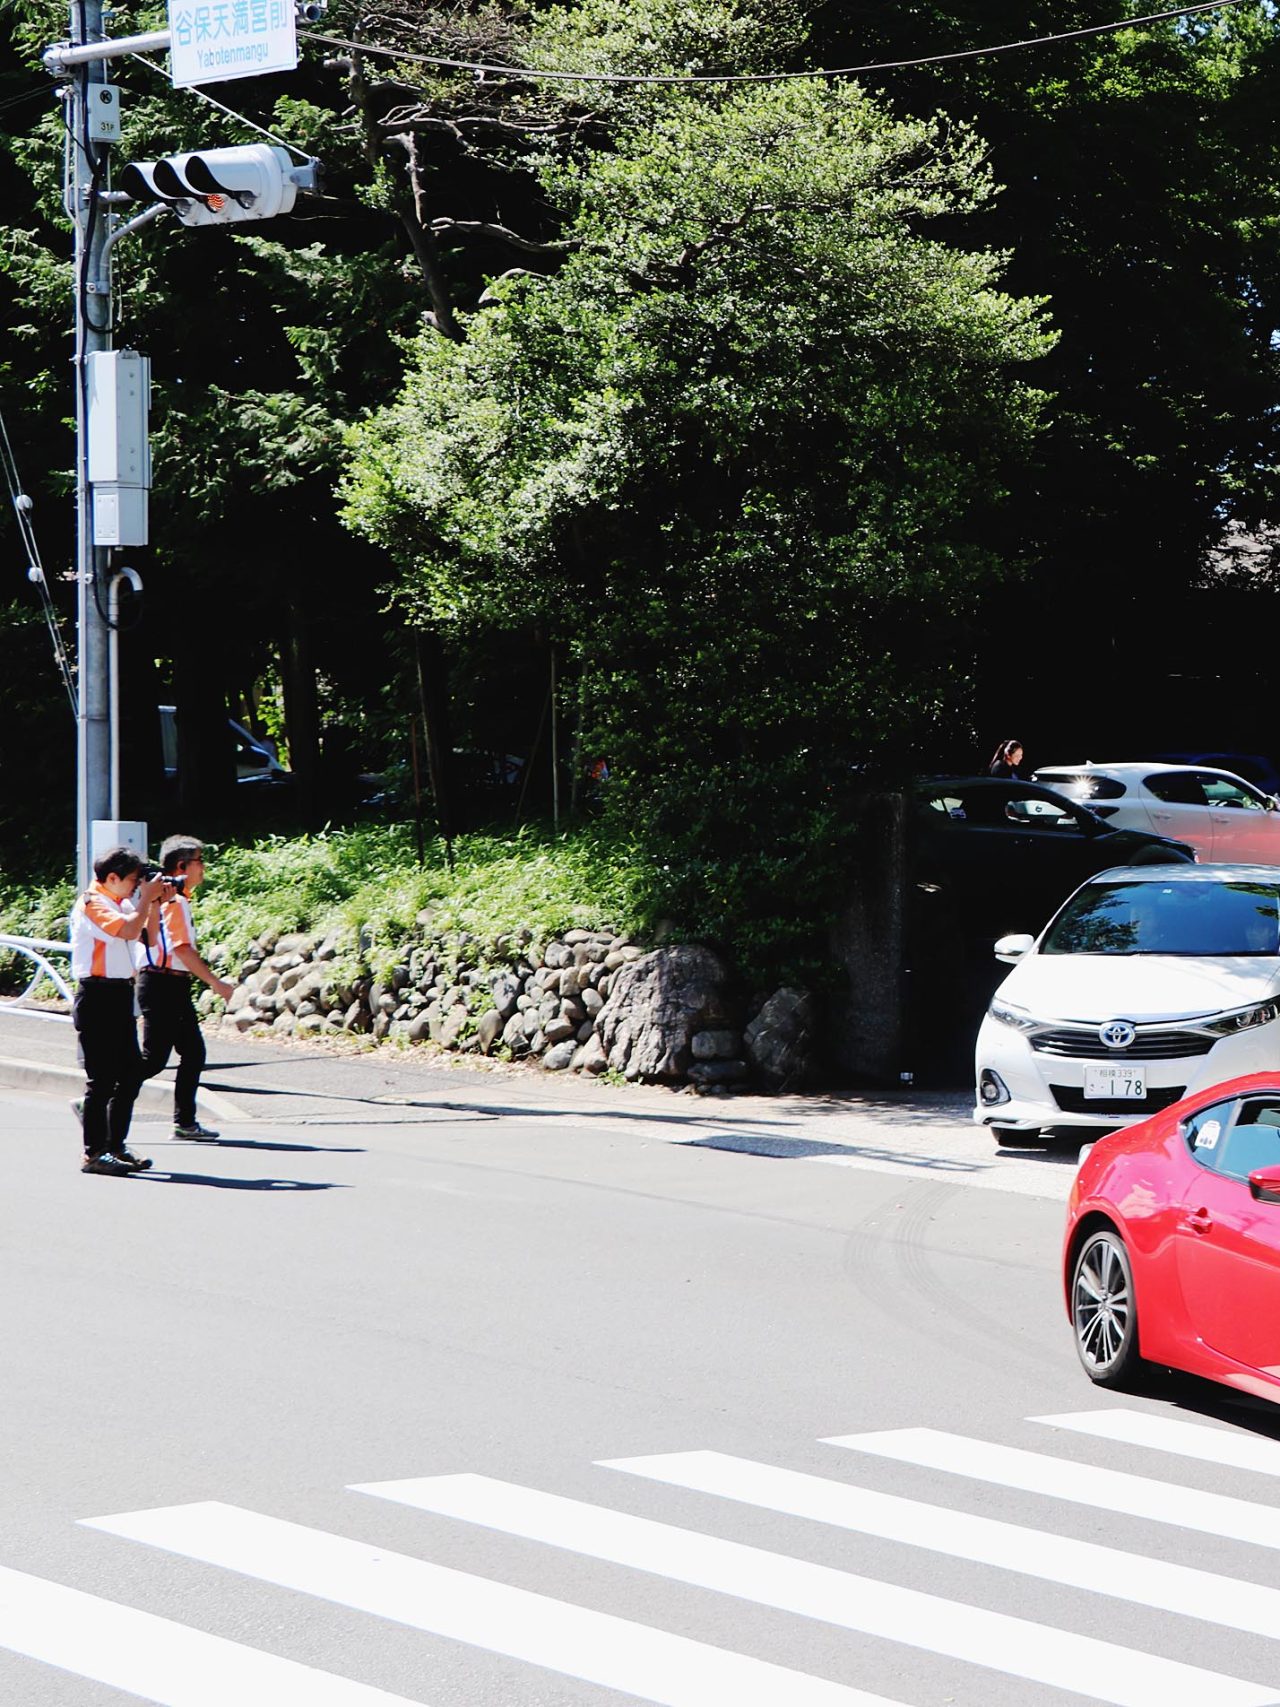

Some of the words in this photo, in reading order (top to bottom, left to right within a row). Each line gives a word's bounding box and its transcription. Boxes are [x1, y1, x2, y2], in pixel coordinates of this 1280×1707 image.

[175, 0, 288, 46] 谷保天満宮前
[197, 43, 269, 68] Yabotenmangu
